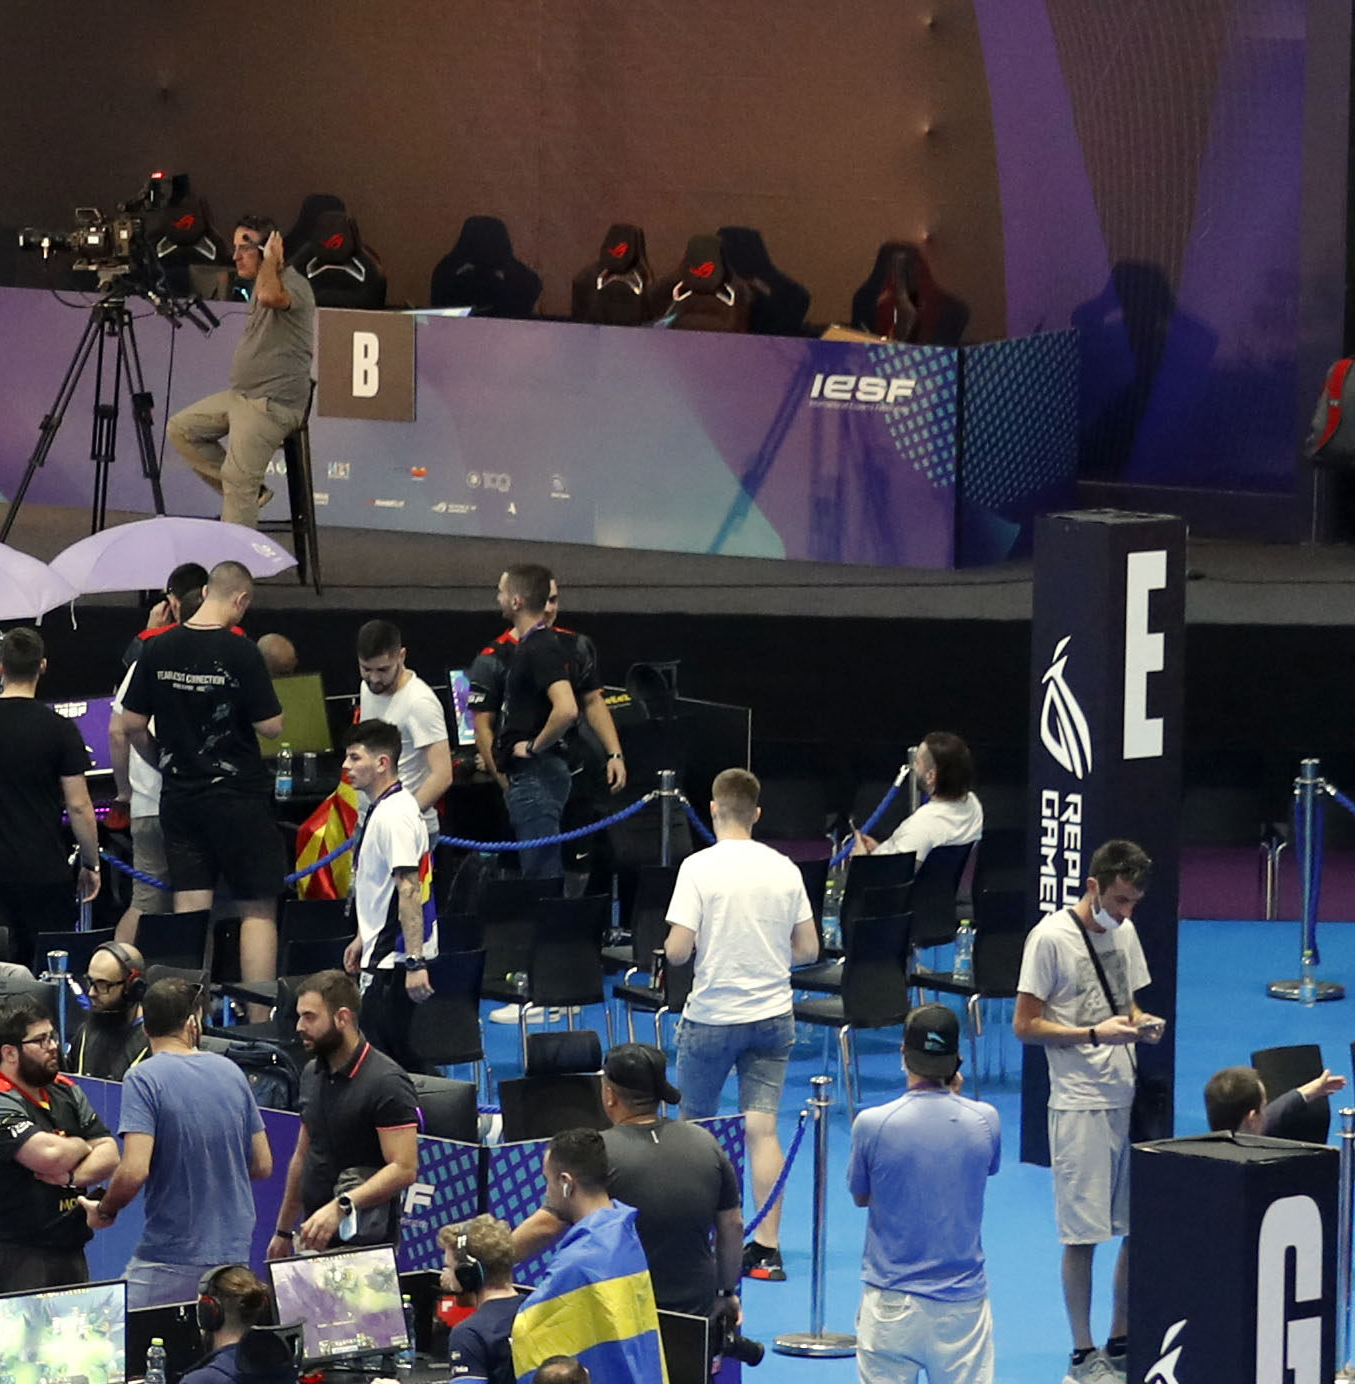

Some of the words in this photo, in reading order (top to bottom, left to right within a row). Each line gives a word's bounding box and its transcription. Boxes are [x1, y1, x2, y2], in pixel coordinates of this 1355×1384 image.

[352, 330, 380, 398] B
[1122, 549, 1168, 760] E
[1256, 1194, 1324, 1384] G
